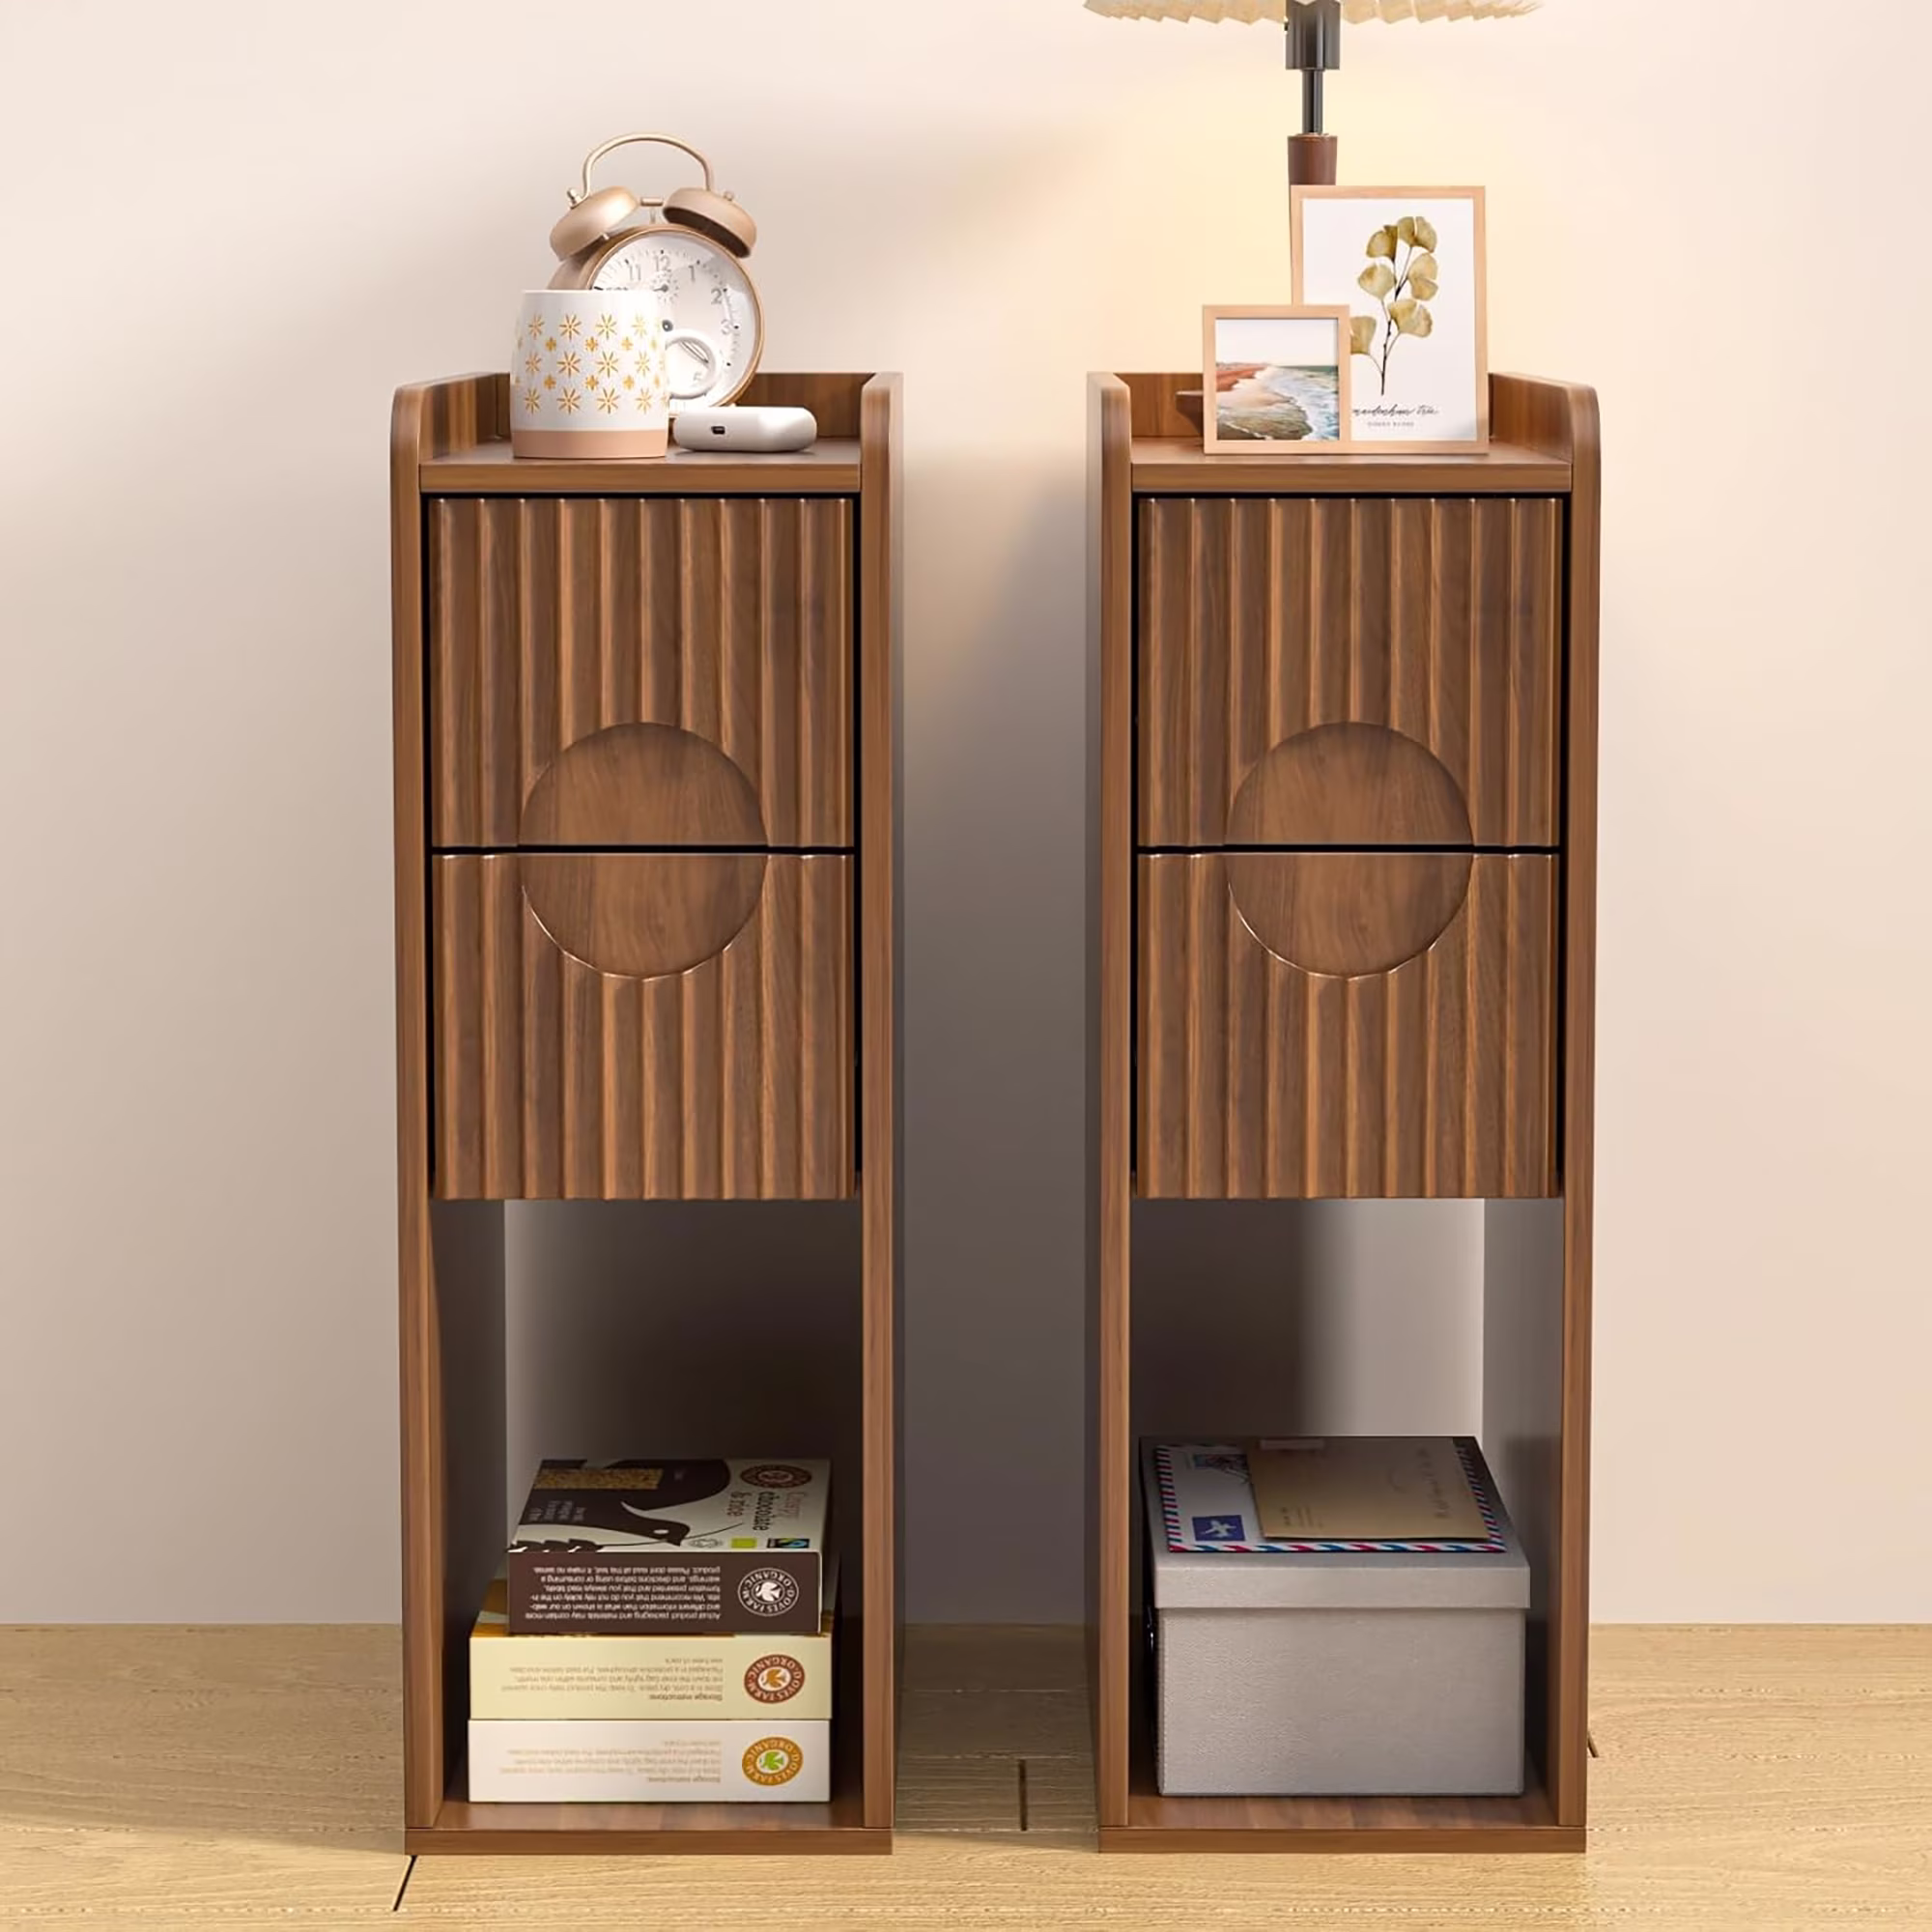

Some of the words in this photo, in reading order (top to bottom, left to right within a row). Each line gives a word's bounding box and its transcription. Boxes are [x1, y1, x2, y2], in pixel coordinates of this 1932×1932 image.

[654, 255, 671, 272] 12
[629, 264, 642, 282] 11
[688, 265, 696, 282] 1
[710, 289, 723, 305] 2
[720, 319, 731, 335] 3
[726, 1500, 750, 1517] rice
[753, 1492, 780, 1531] chocolate
[595, 1575, 614, 1583] using
[672, 1575, 686, 1583] and
[744, 1571, 792, 1587] ORGANIC
[609, 1584, 622, 1592] you
[623, 1584, 637, 1592] that
[638, 1584, 651, 1592] and
[540, 1593, 552, 1602] the
[553, 1593, 563, 1602] on
[598, 1593, 609, 1602] not
[610, 1593, 620, 1602] do
[621, 1593, 635, 1602] you
[636, 1593, 649, 1602] that
[651, 1593, 692, 1602] recommend
[693, 1593, 706, 1602] We
[571, 1612, 586, 1620] may
[619, 1612, 633, 1620] and
[671, 1612, 697, 1620] product
[747, 1657, 796, 1679] ORGANIC
